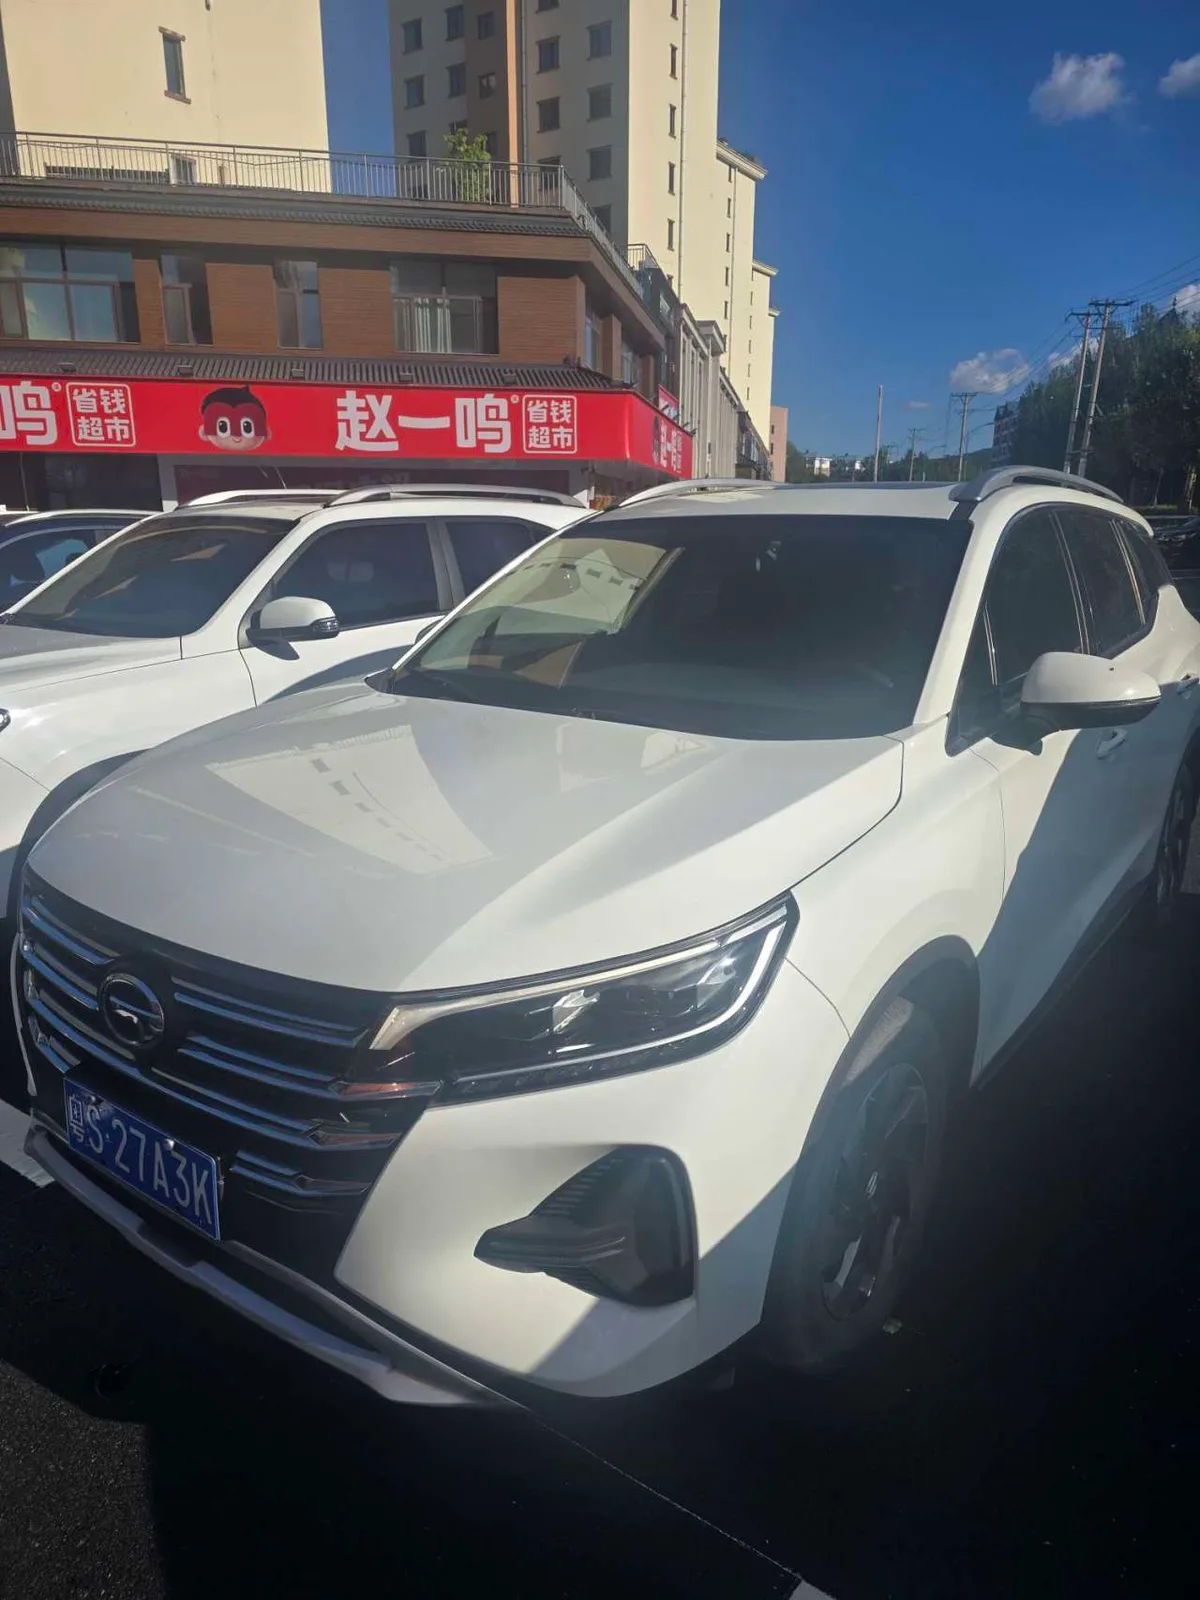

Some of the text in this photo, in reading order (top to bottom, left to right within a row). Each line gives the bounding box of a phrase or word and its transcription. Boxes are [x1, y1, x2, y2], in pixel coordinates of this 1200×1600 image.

[73, 388, 126, 413] 省钱
[527, 400, 571, 424] 省钱
[77, 416, 130, 441] 超市
[335, 390, 512, 453] 赵一鸣
[528, 426, 573, 449] 超市
